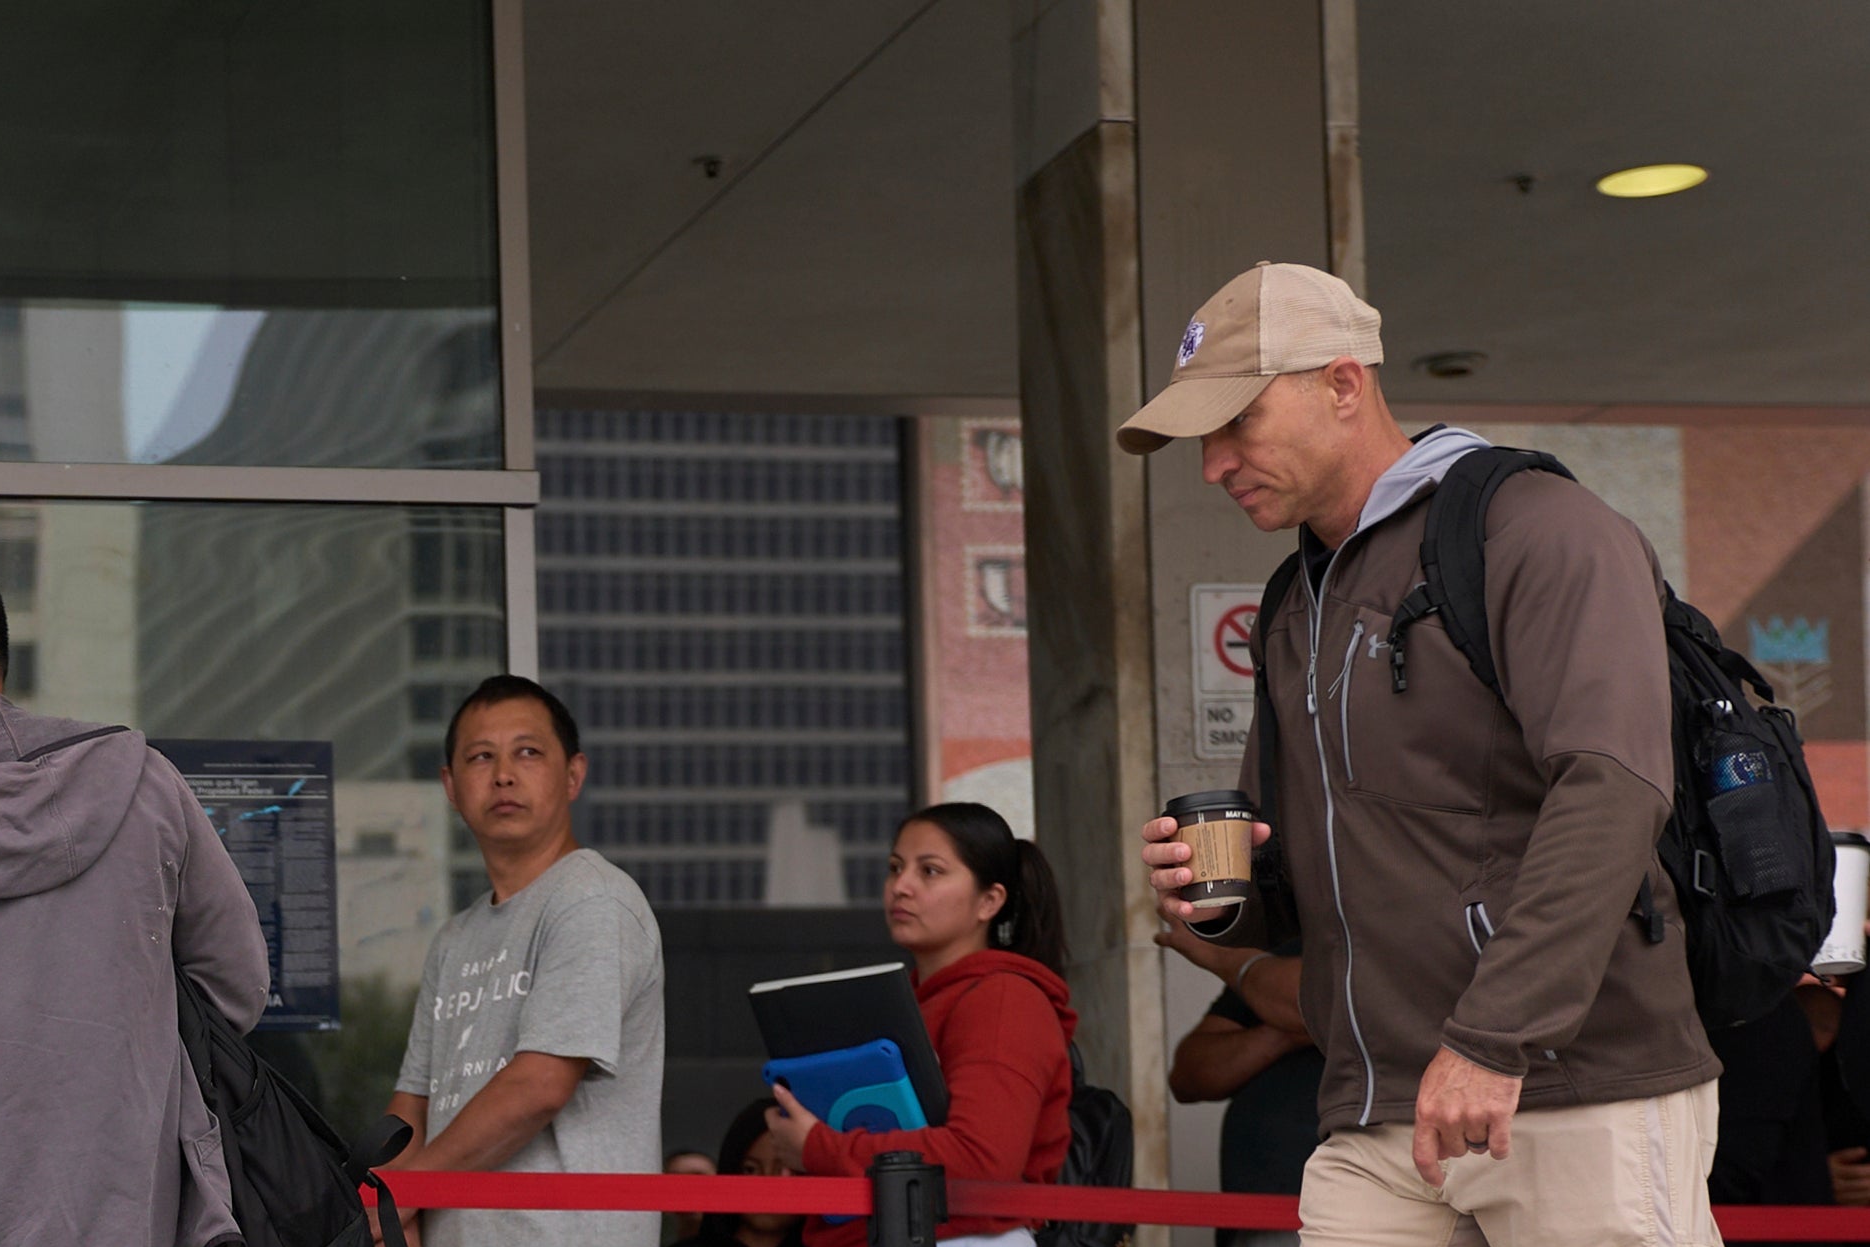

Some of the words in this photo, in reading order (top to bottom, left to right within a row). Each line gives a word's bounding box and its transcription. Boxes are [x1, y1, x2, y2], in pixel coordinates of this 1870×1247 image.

[1207, 708, 1235, 723] NO
[1209, 730, 1248, 745] SMO
[433, 970, 531, 1021] REPULIC
